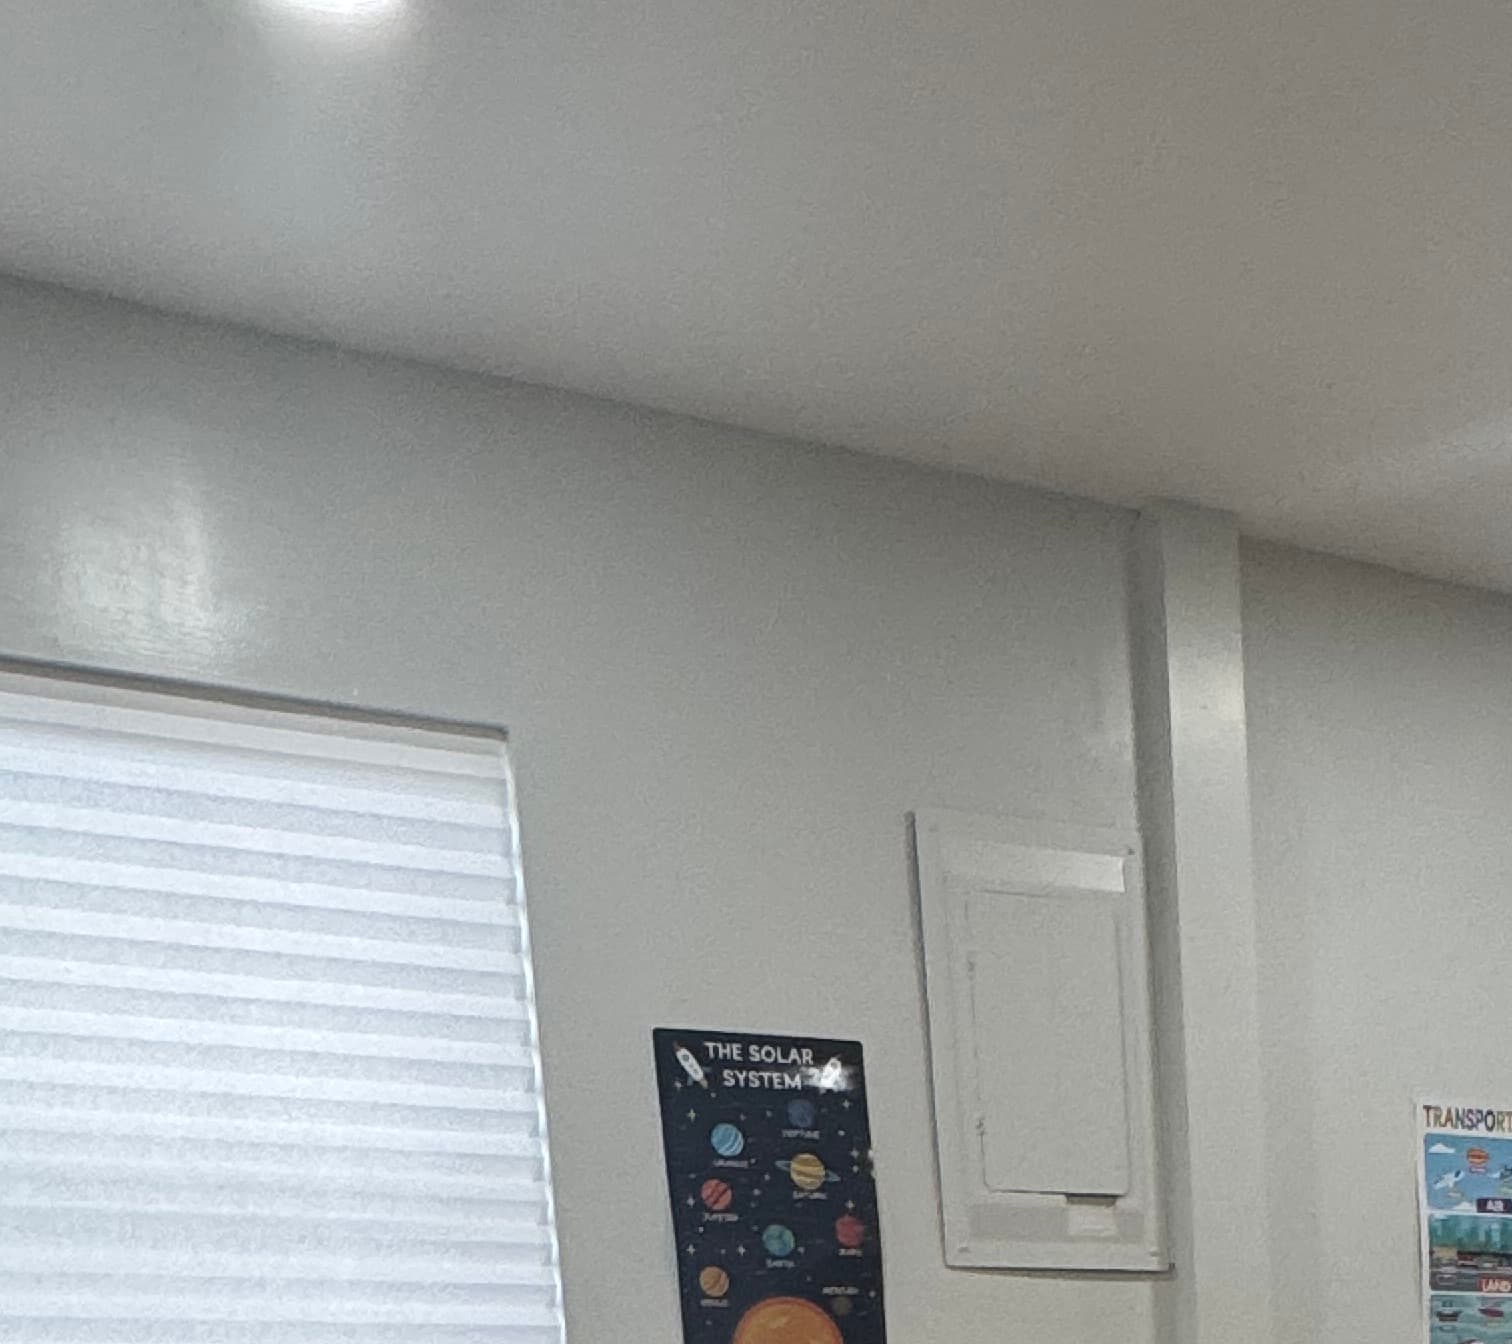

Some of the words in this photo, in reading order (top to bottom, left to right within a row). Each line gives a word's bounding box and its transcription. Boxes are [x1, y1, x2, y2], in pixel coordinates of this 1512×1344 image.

[703, 1041, 742, 1062] THE
[748, 1045, 814, 1066] SOLAR
[722, 1070, 801, 1090] SYSTEM
[1481, 1277, 1512, 1292] LAND
